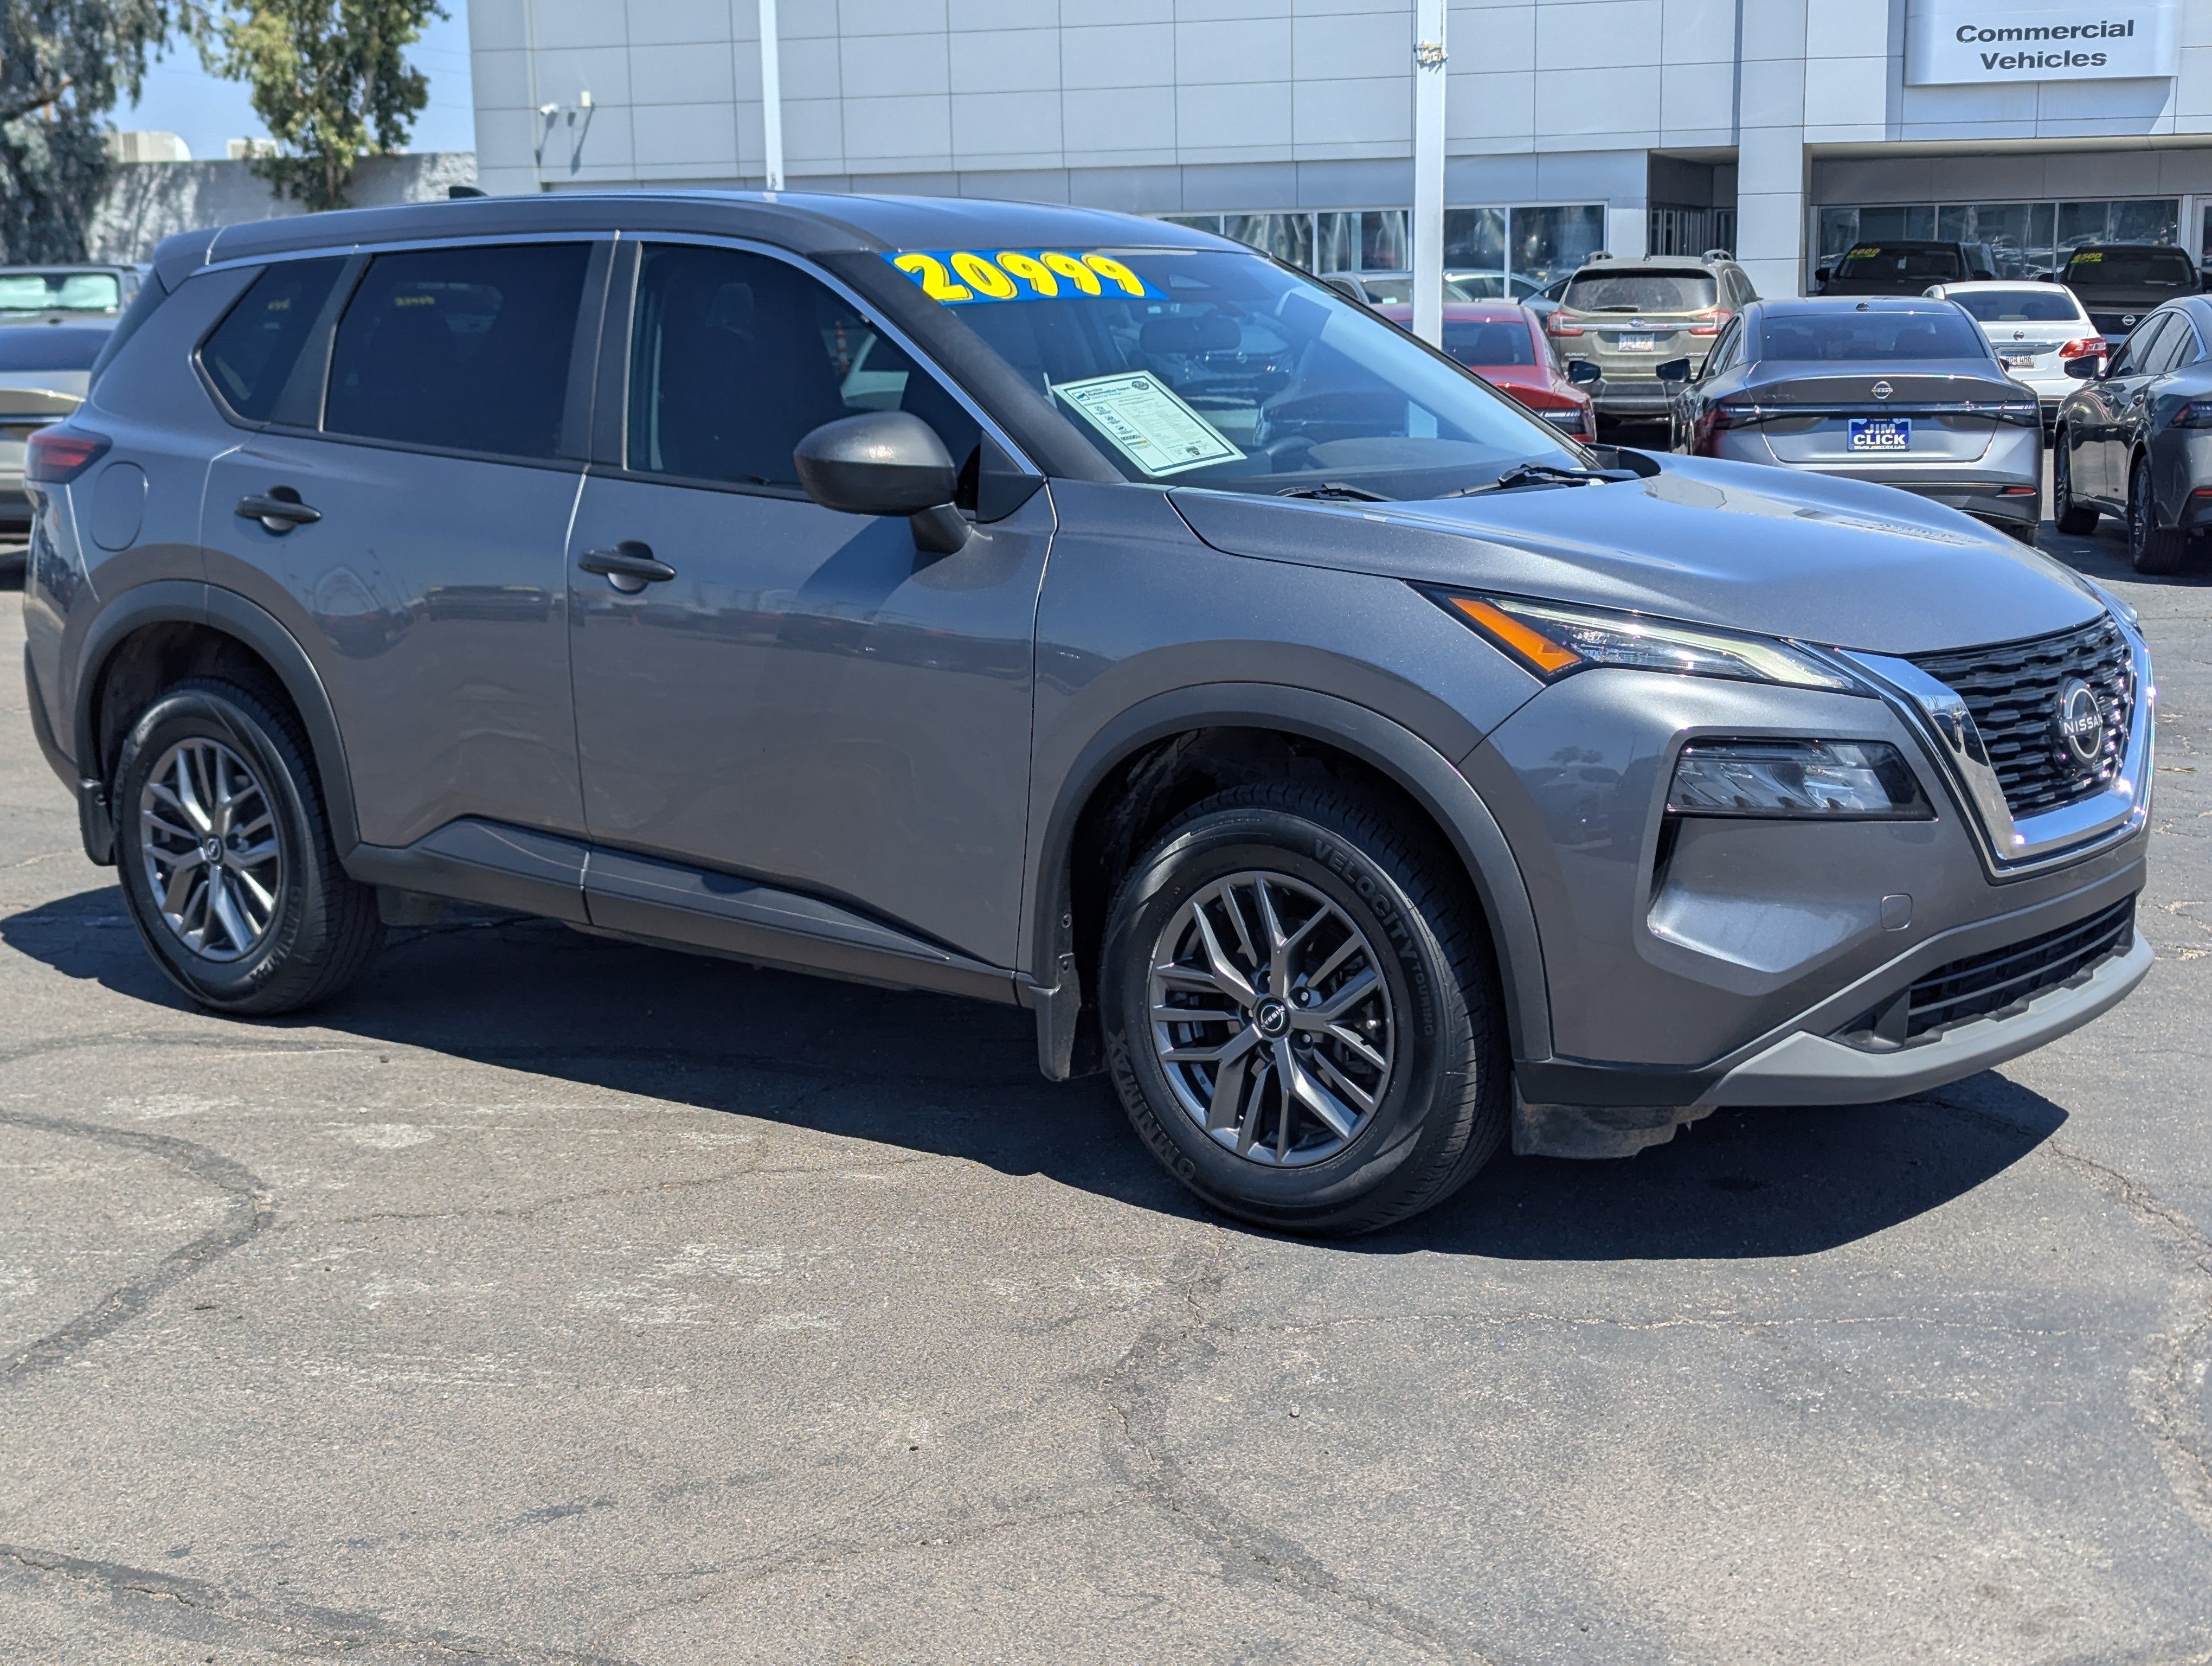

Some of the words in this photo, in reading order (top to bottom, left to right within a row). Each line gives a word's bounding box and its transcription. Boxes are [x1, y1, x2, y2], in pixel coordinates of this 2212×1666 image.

[1956, 20, 2134, 43] Commercial
[1980, 50, 2107, 70] Vehicles
[893, 252, 1145, 300] 20999
[1853, 434, 1906, 445] CLICK
[1864, 424, 1895, 434] JIM
[2063, 714, 2102, 734] NISSAN
[1315, 839, 1418, 959] VELOCITY
[1411, 960, 1434, 1037] TOURING
[1261, 1005, 1285, 1030] NISSAN
